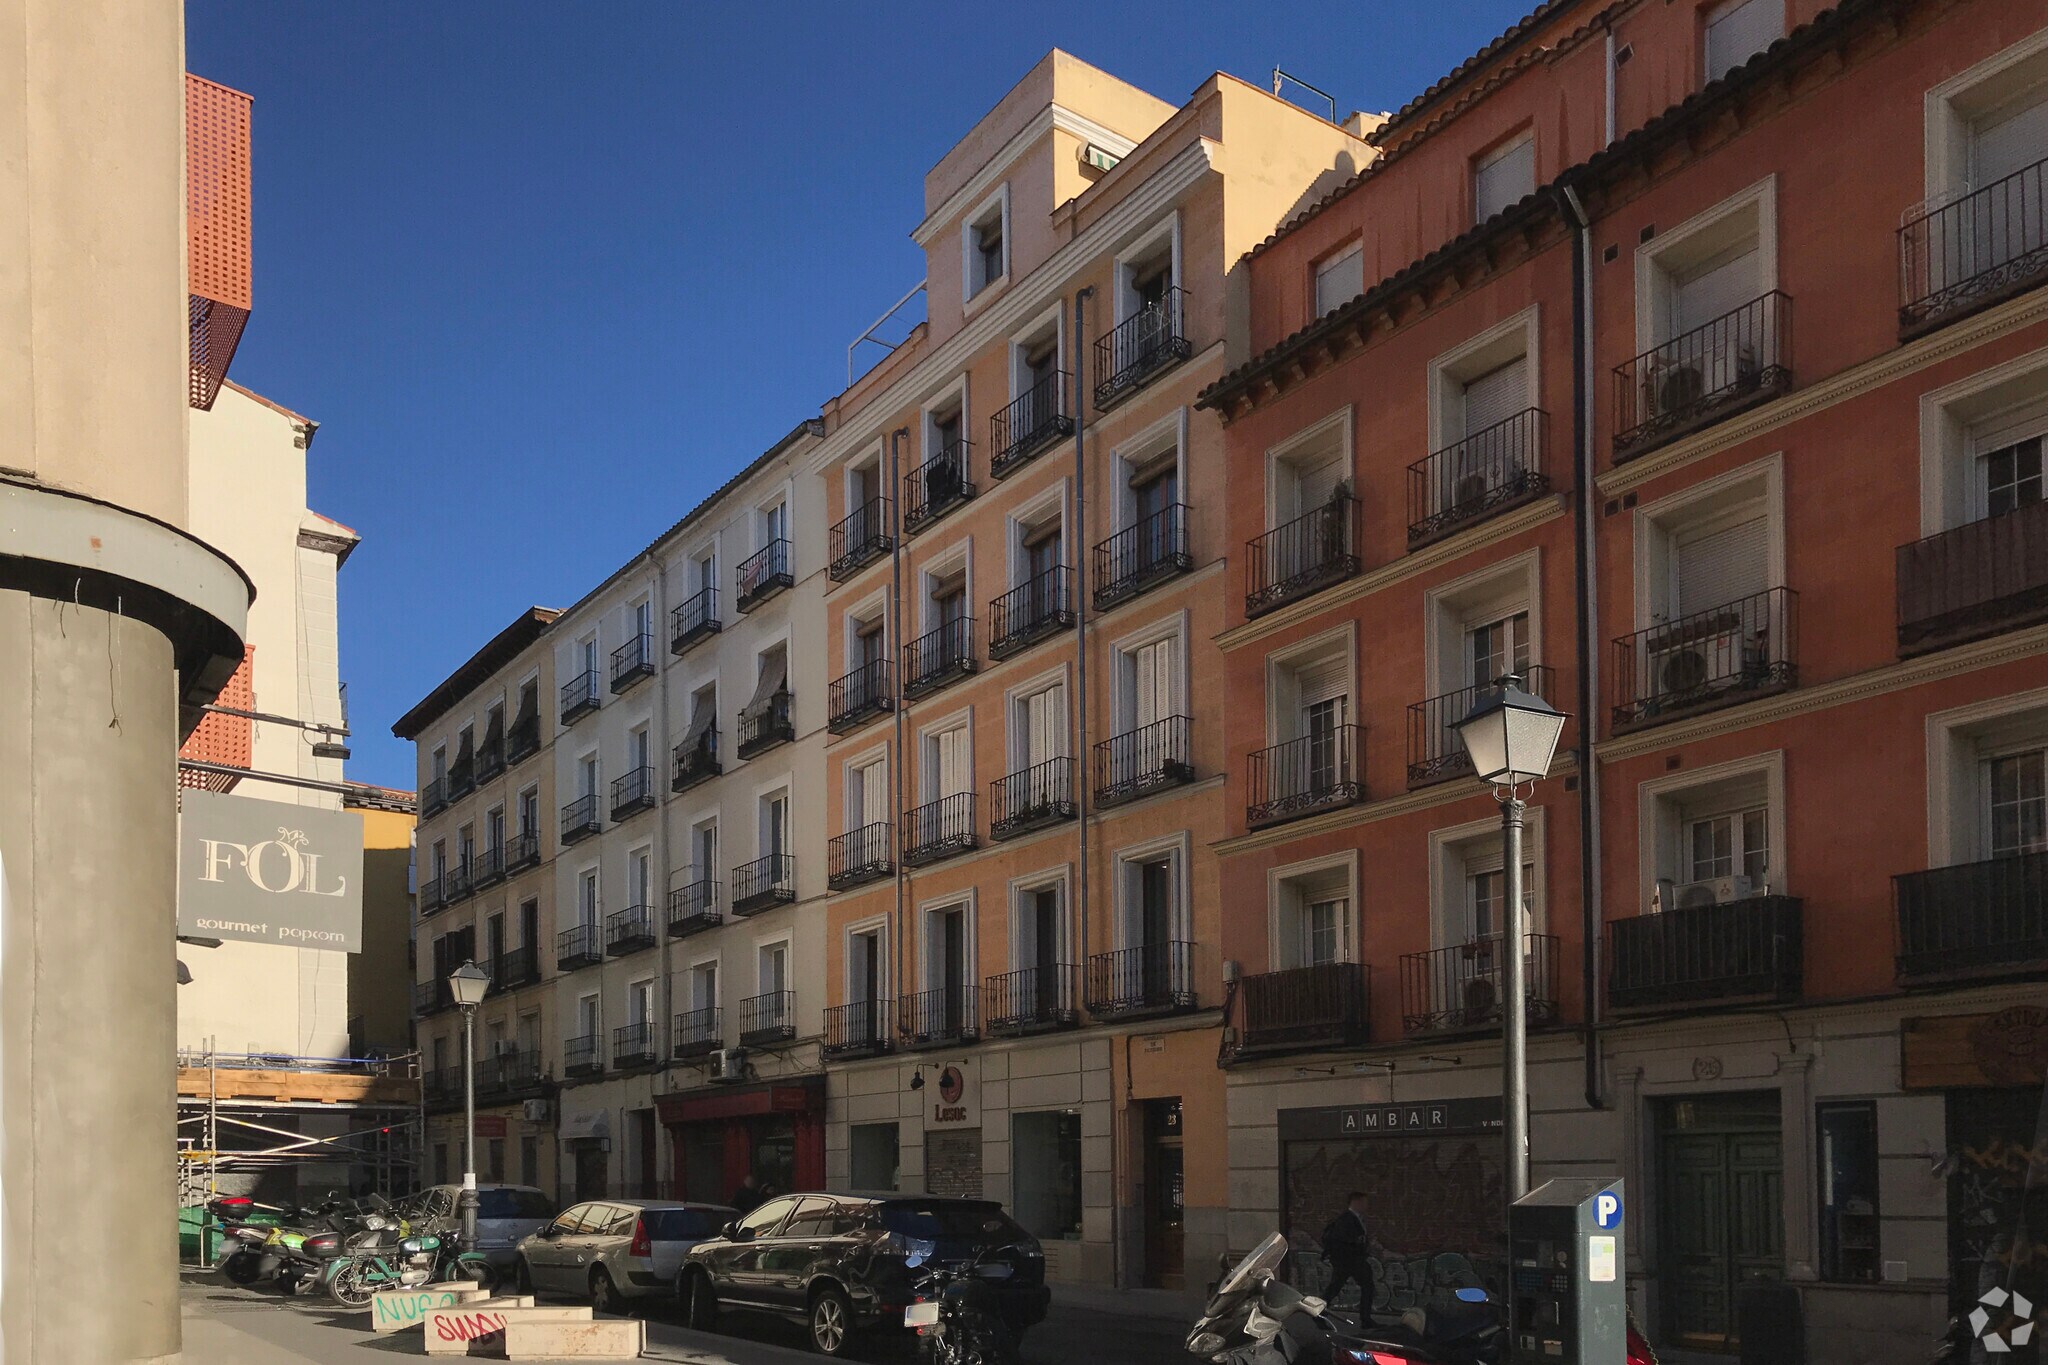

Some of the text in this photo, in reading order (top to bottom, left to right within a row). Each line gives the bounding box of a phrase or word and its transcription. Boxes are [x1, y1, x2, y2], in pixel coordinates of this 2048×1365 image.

[196, 918, 346, 943] gourmet popcorn
[1346, 1110, 1442, 1128] AMBAR
[1598, 1195, 1617, 1226] P
